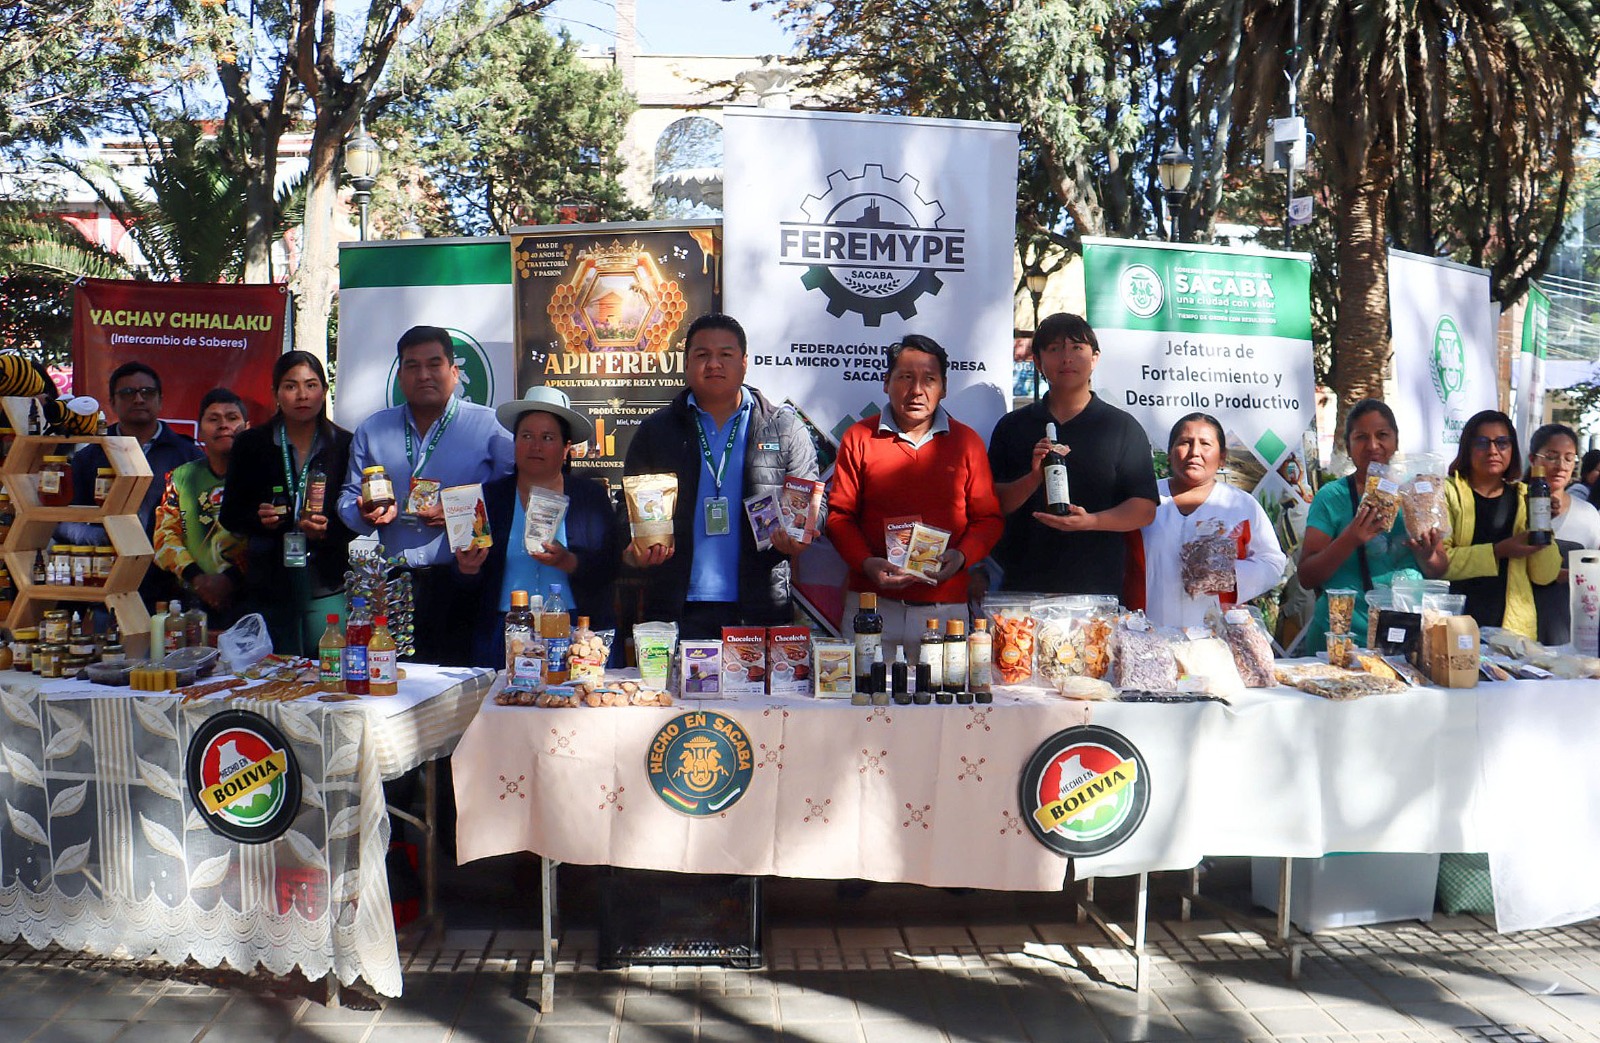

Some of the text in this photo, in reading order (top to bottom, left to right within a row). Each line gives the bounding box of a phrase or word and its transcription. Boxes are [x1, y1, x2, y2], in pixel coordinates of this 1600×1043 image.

[780, 229, 965, 264] FEREMYPE
[526, 260, 569, 268] TRAYECTORIA
[851, 270, 893, 280] SACABA
[1175, 274, 1275, 298] SACABA
[1176, 296, 1276, 309] una ciudad con valor
[90, 309, 272, 332] YACHAY CHHALAKU
[111, 333, 248, 350] (Intercambio de Saberes)
[790, 342, 878, 355] FEDERACIÓN
[1165, 340, 1255, 359] Jefatura de
[544, 351, 685, 376] APIFEREVI
[754, 356, 986, 372] DE LA MICRO Y PEQU PRESA
[600, 379, 632, 387] FELIPE
[634, 379, 656, 387] RELY
[658, 379, 685, 387] VIDAL
[1142, 365, 1282, 388] Fortalecimiento y
[1126, 390, 1300, 410] Desarrollo Productivo
[571, 460, 624, 468] MBINACIONES
[650, 714, 751, 774] HECHO EN SACABA
[220, 758, 248, 779] HECHO EN
[212, 760, 278, 804] BOLIVIA
[1061, 770, 1094, 794] HECHO EN
[1050, 770, 1126, 820] BOLIVIA
